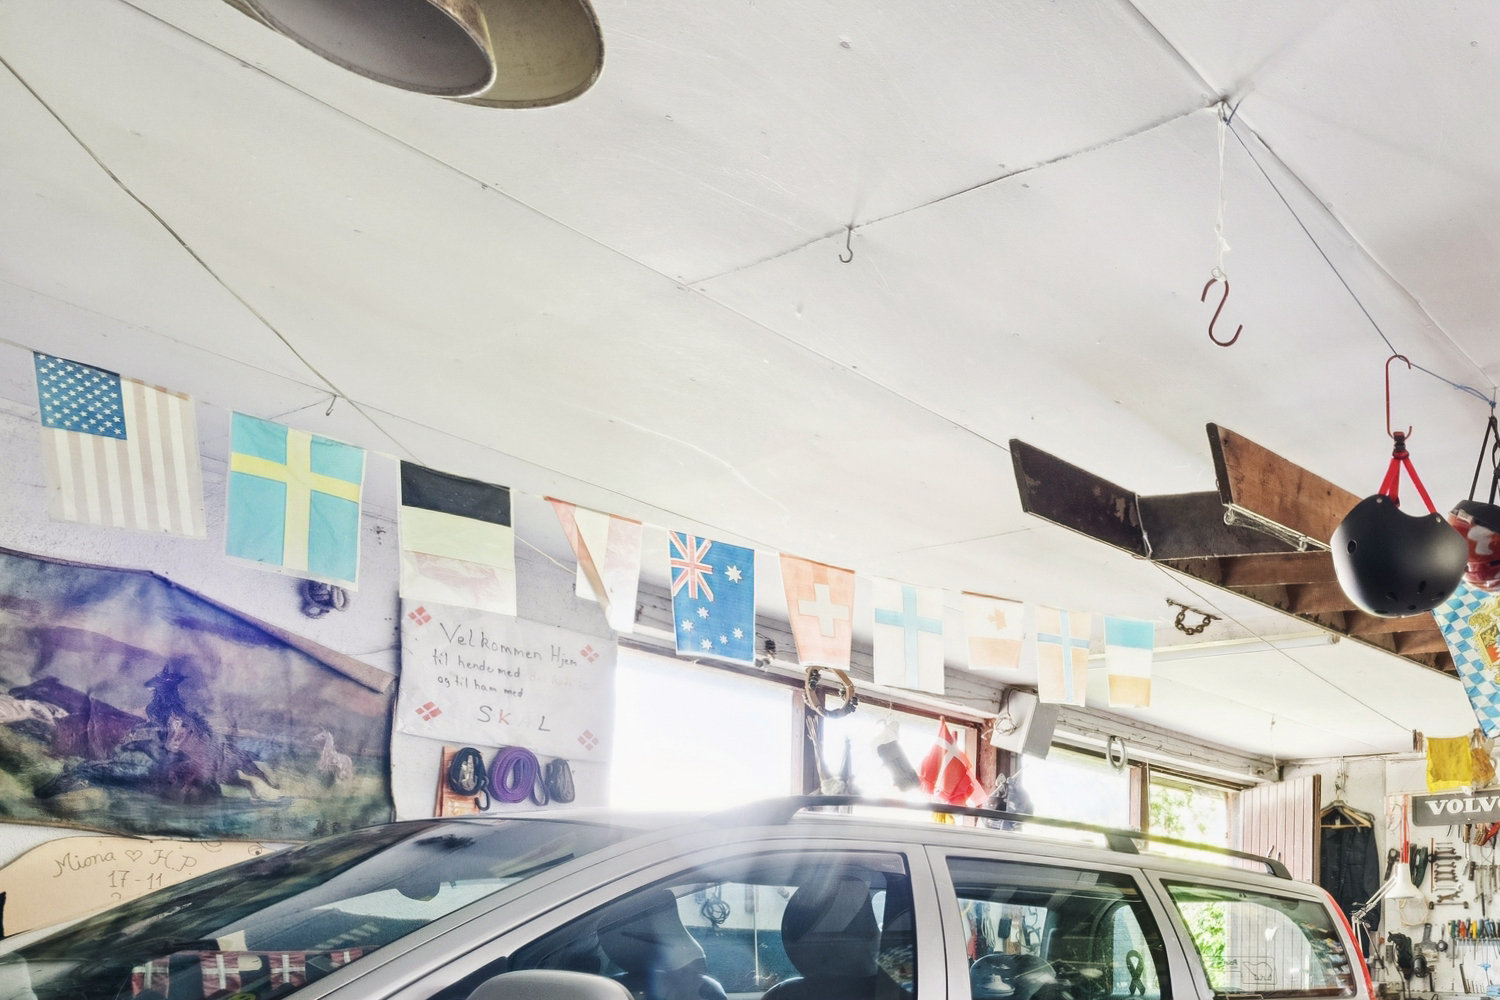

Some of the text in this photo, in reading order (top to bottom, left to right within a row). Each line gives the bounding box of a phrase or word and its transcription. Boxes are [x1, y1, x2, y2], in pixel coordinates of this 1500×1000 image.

[440, 623, 577, 668] Velkommen Hjem
[432, 649, 520, 678] til hende med
[437, 676, 524, 698] og til ham med
[52, 848, 116, 878] Miona
